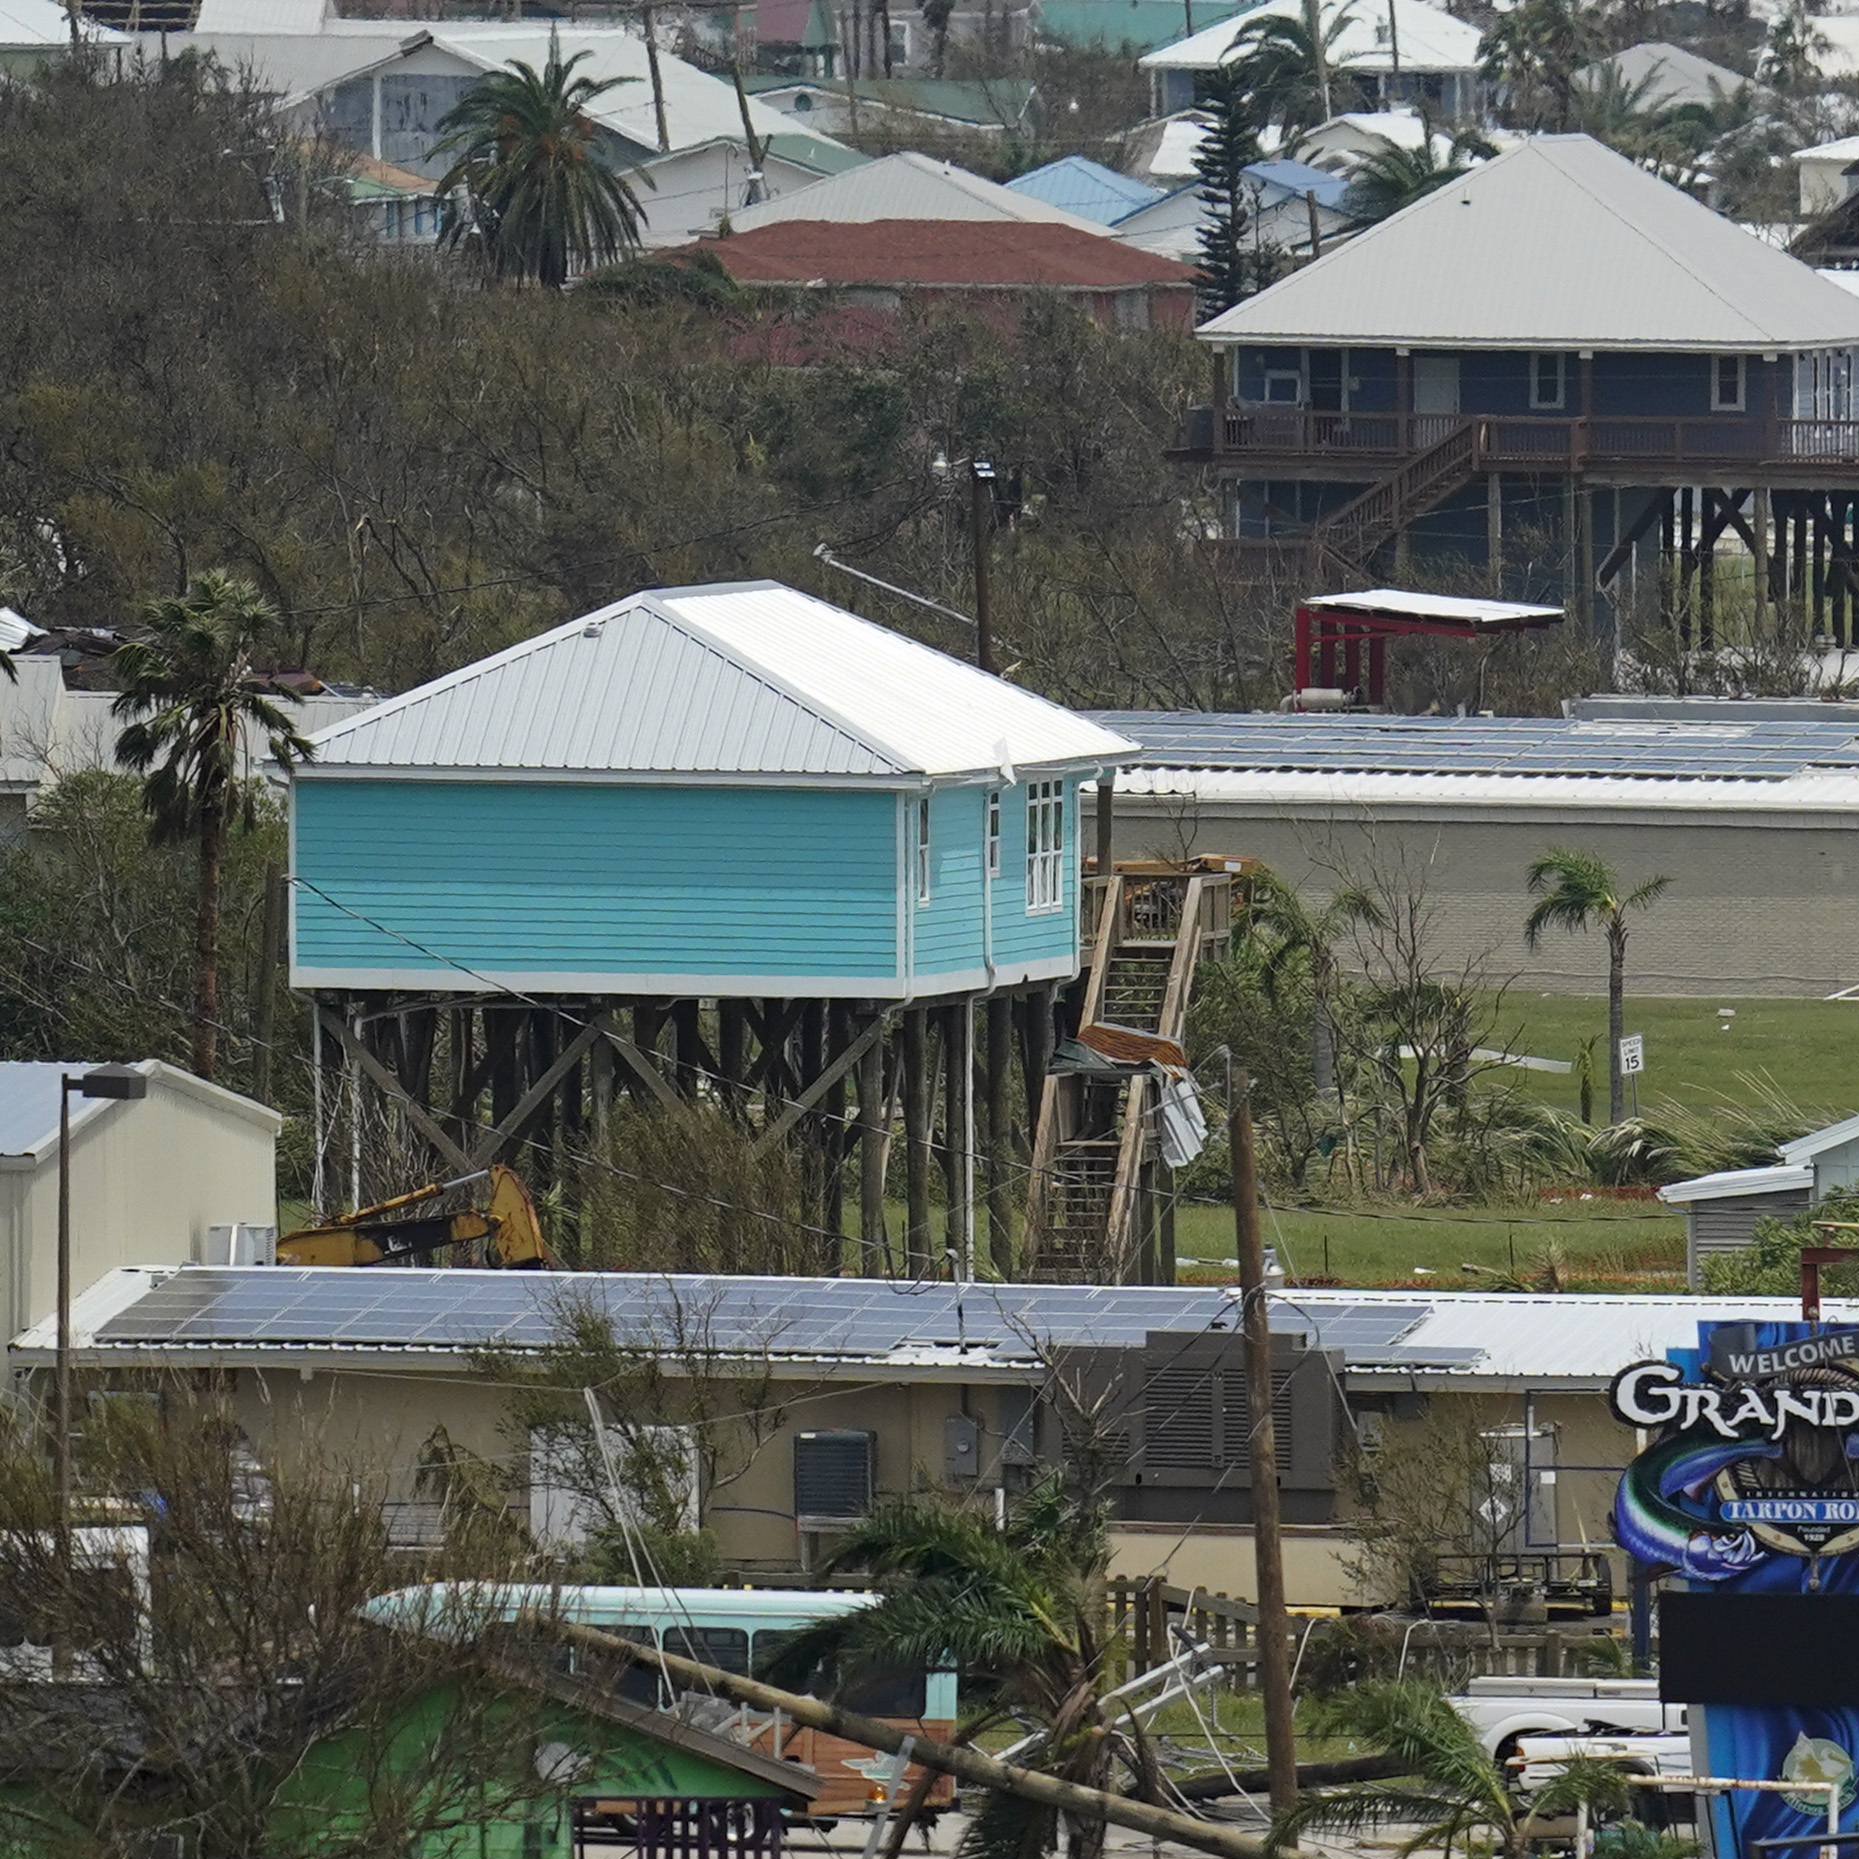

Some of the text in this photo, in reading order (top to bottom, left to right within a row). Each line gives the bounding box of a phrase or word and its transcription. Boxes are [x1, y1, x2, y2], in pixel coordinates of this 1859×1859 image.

[1626, 1055, 1640, 1070] 15
[1728, 1336, 1856, 1375] WELCOME
[1728, 1502, 1817, 1520] TARPON
